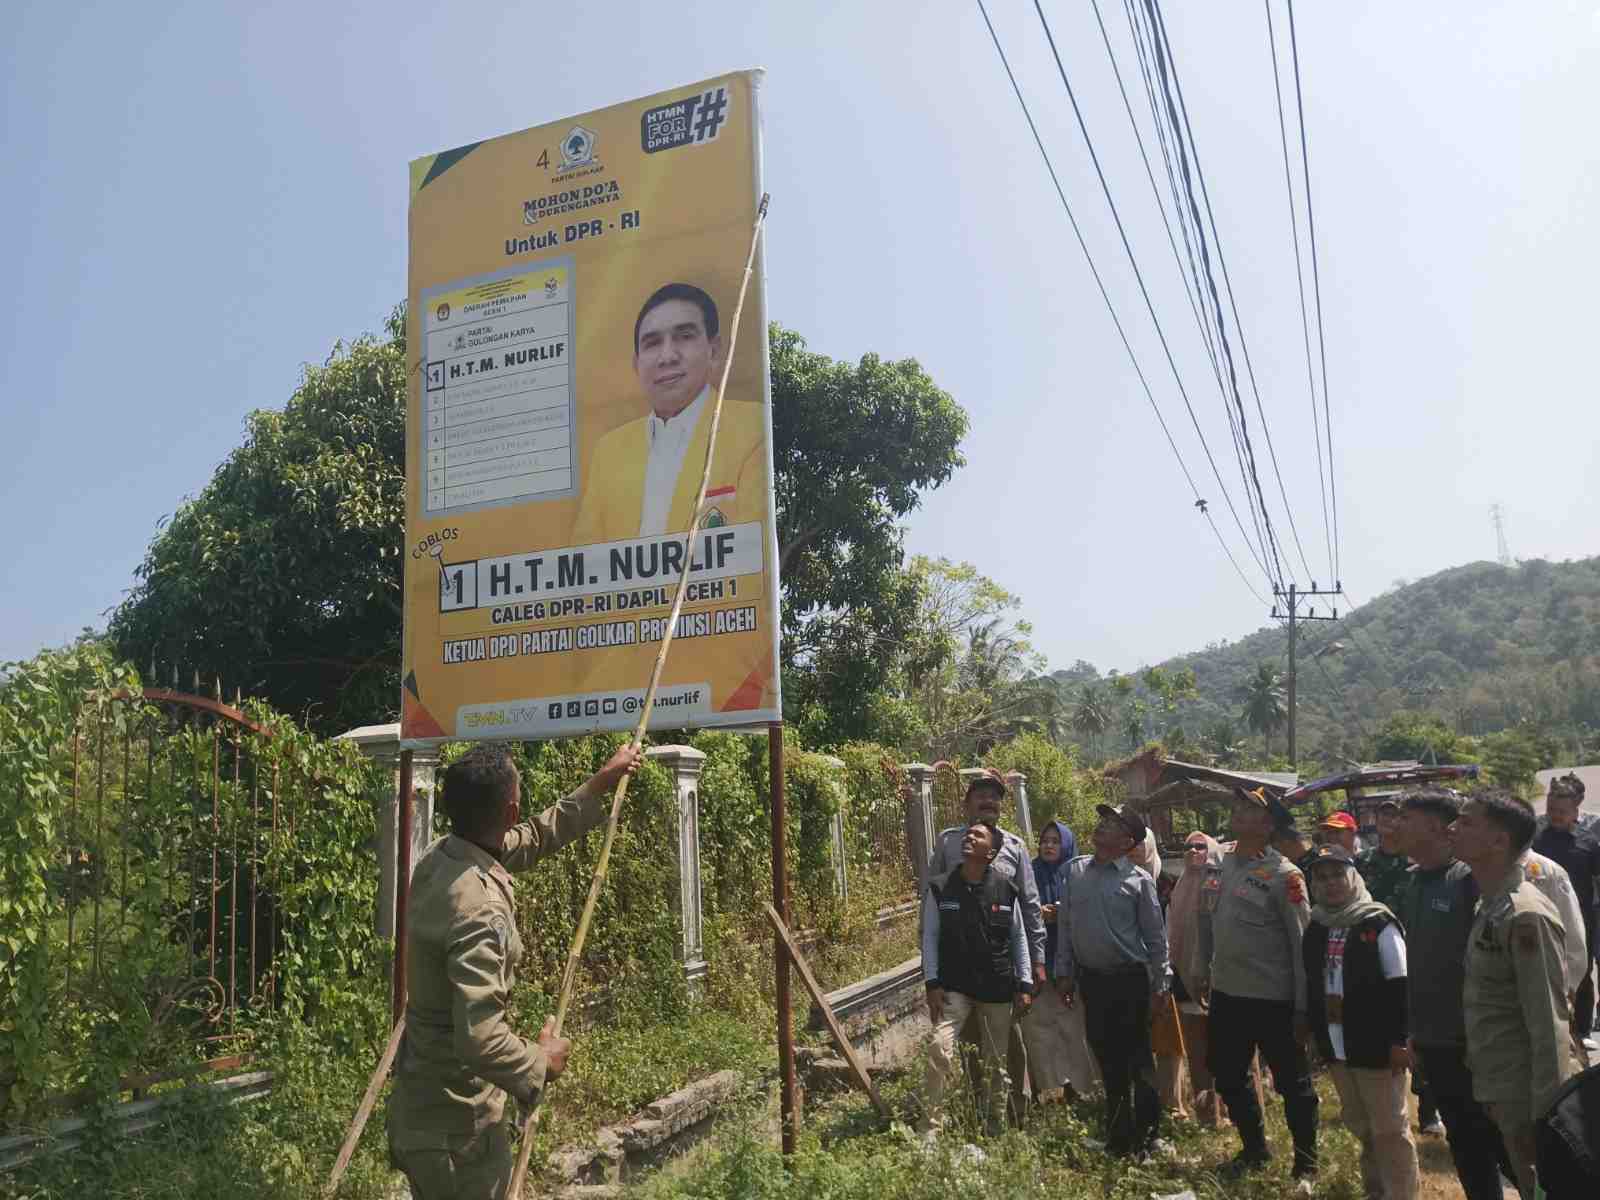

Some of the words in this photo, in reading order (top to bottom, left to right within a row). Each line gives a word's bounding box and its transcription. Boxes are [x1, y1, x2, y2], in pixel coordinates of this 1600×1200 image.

[647, 104, 685, 124] HTMN
[648, 117, 687, 140] FOR
[536, 149, 550, 169] 4
[523, 189, 579, 211] MOHON
[583, 180, 620, 199] DO'A
[505, 230, 558, 255] Untuk
[564, 219, 603, 242] DPR
[620, 210, 640, 230] RI
[450, 357, 499, 379] H.T.M.
[504, 342, 566, 368] NURLIF
[412, 527, 459, 560] COBLOS
[453, 569, 464, 604] 1
[490, 552, 598, 596] H.T.M.
[491, 602, 545, 625] CALEG
[549, 594, 612, 617] DPR-RI
[616, 587, 669, 609] DAPIL
[673, 580, 723, 603] CEH
[729, 578, 737, 597] 1
[443, 636, 487, 664] KETUA
[489, 633, 518, 659] DPD
[521, 627, 574, 656] PARTAI
[576, 620, 638, 649] GOLKAR
[715, 606, 757, 635] ACEH
[622, 689, 701, 714] @t.nurlif
